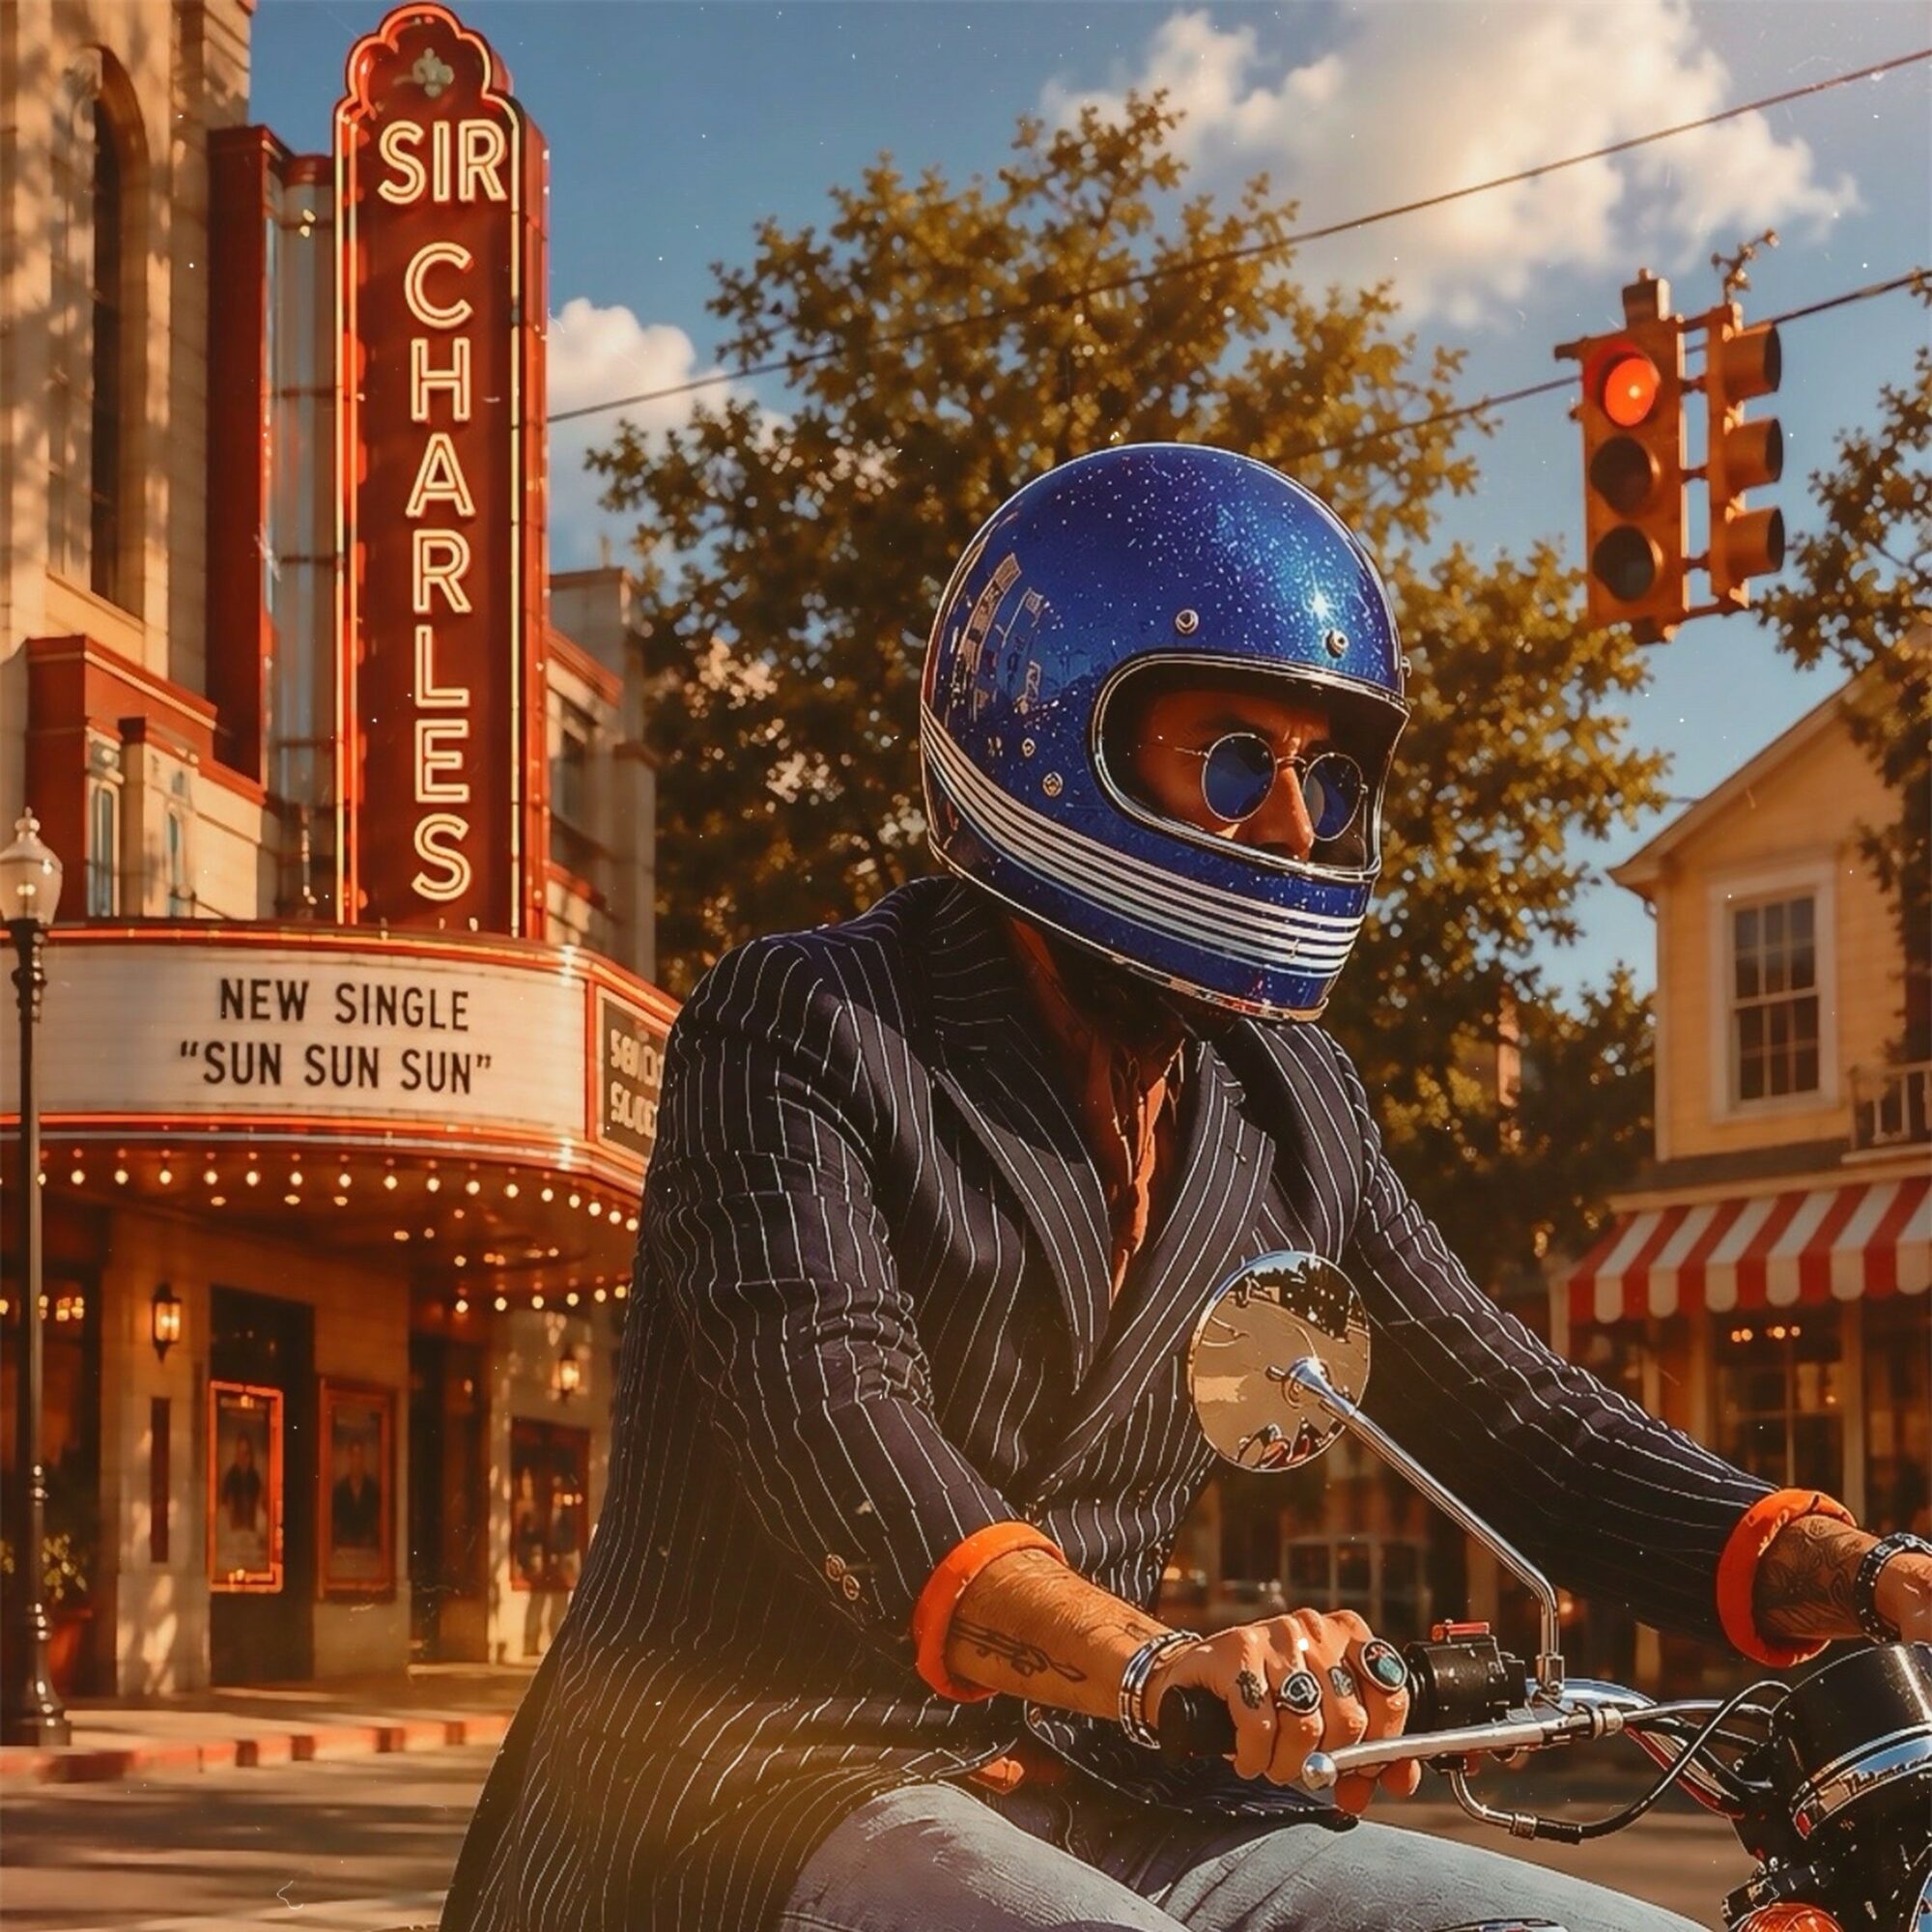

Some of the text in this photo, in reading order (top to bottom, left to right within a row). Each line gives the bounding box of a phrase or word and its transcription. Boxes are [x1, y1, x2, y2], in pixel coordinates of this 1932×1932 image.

[378, 119, 507, 204] SIR
[404, 242, 475, 901] CHARLES
[219, 978, 469, 1032] NEW SINGLE
[180, 1040, 492, 1094] “SUN SUN SUN”
